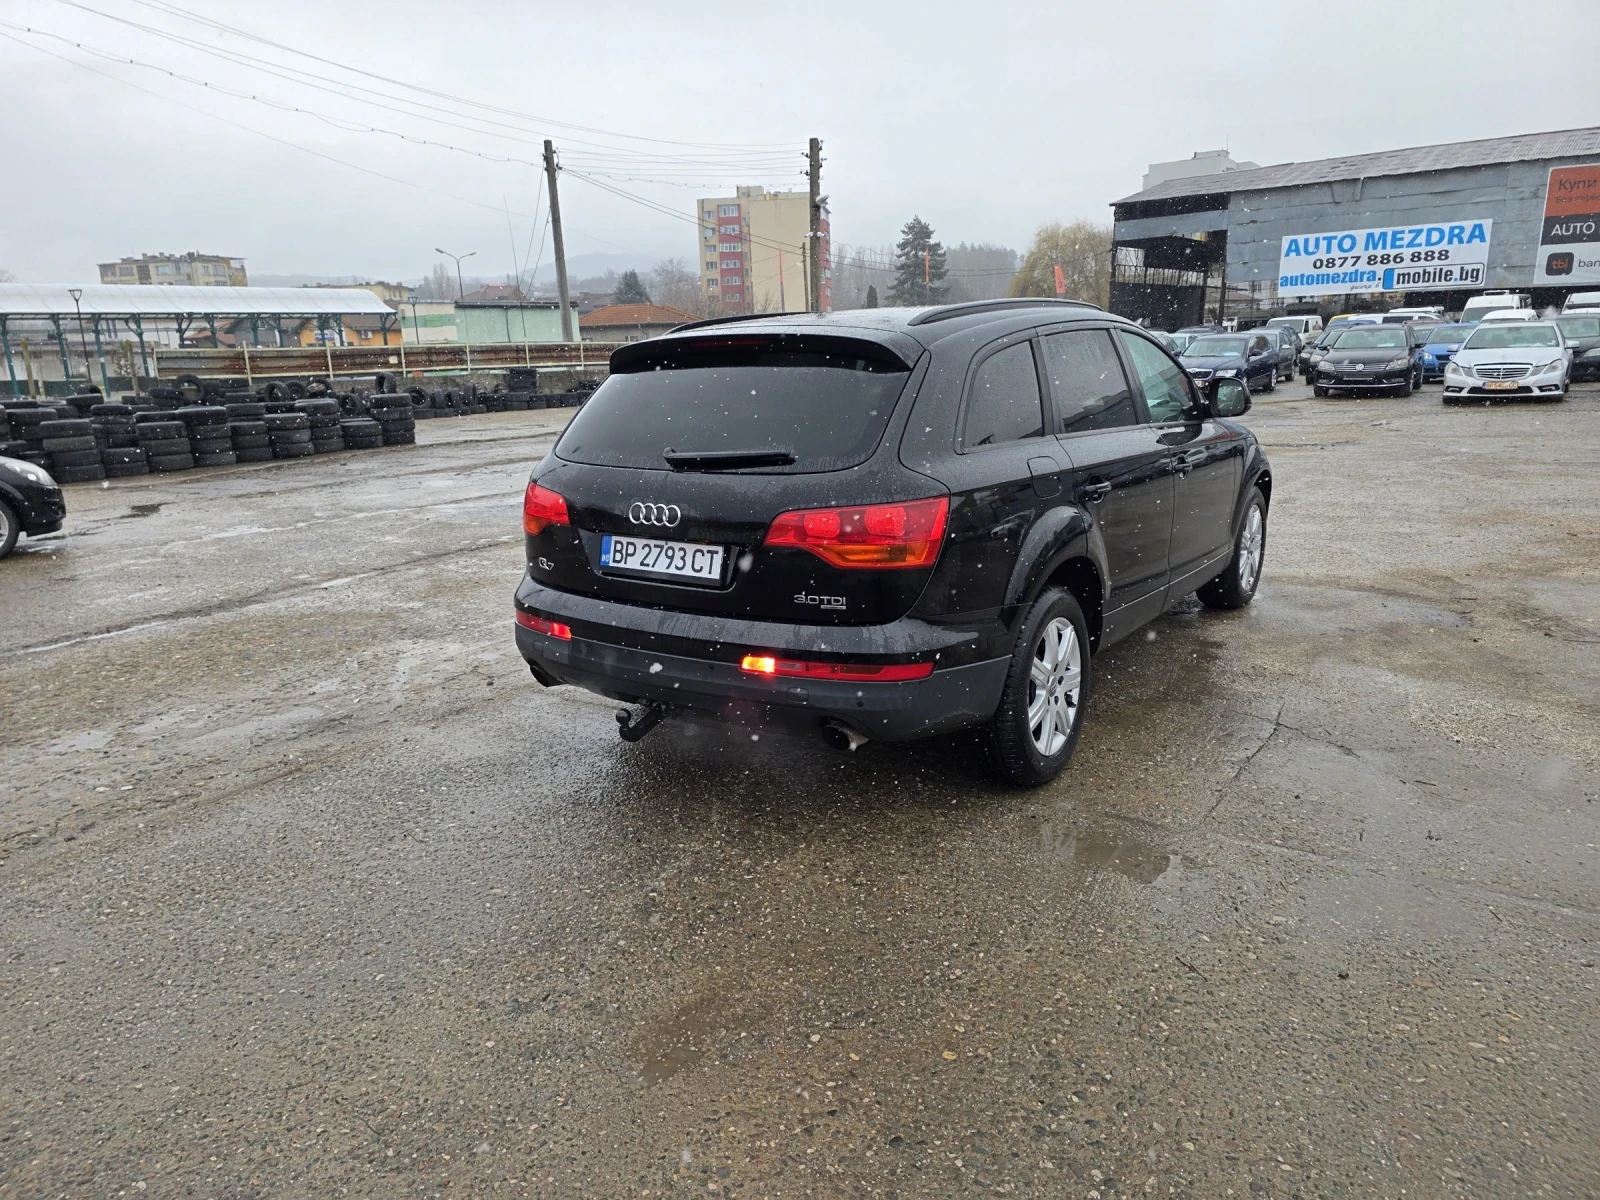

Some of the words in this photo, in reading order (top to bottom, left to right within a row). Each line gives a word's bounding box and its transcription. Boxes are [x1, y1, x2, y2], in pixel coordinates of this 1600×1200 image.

[1558, 179, 1597, 193] Купи
[1551, 222, 1595, 236] AUTO
[1284, 234, 1357, 257] AUTO
[1364, 223, 1487, 252] MEZDRA
[1313, 255, 1361, 269] 0877
[1366, 252, 1405, 266] 886
[1410, 249, 1450, 262] 888
[1551, 259, 1569, 269] tbi
[538, 556, 555, 571] Q7
[612, 540, 637, 565] BP
[639, 543, 687, 571] 2793
[691, 548, 719, 575] CT
